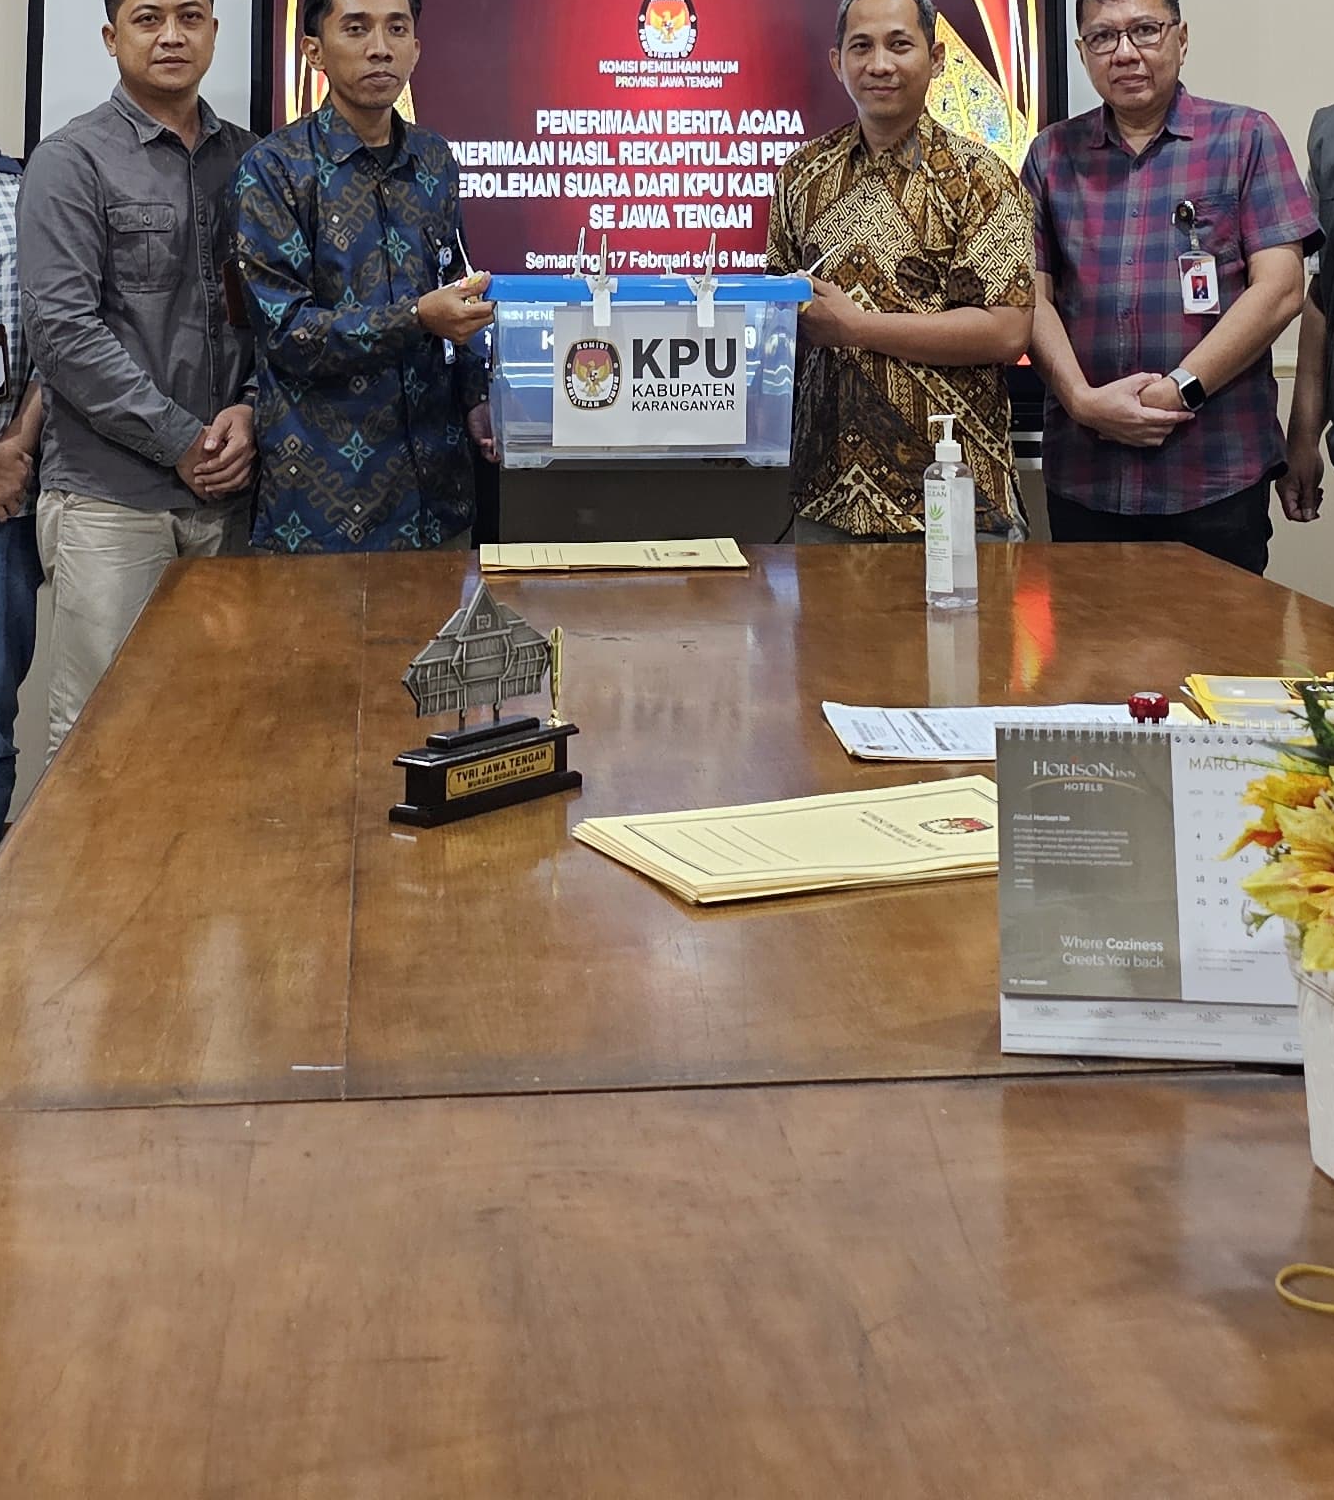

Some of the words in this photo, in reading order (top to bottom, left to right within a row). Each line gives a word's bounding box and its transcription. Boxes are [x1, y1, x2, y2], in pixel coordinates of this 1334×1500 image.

[599, 61, 638, 73] KOMISI
[640, 61, 701, 73] PEMILIHAN
[703, 61, 738, 73] UMUM
[616, 76, 658, 88] PROVINSI
[660, 76, 685, 88] JAWA
[686, 76, 722, 88] TENGAH
[536, 110, 662, 134] PENERIMAAN
[667, 110, 733, 134] BERITA
[737, 110, 804, 134] ACARA
[558, 141, 615, 166] HASIL
[619, 141, 757, 166] REKAPITULASI
[564, 172, 634, 198] SUARA
[636, 172, 679, 198] DARI
[684, 172, 724, 198] KPU
[589, 204, 616, 229] SE
[618, 204, 669, 229] JAWA
[673, 204, 752, 229] TENGAH
[607, 251, 627, 269] 17
[629, 250, 691, 269] Februari
[719, 251, 729, 269] 6
[632, 338, 737, 379] KPU
[632, 383, 735, 398] KABUPATEN
[631, 400, 735, 412] KARANGANYAR
[456, 770, 479, 783] TVRI
[481, 761, 507, 776] JAWA
[508, 749, 547, 768] TENGAH
[1189, 756, 1247, 771] MARCH
[1116, 770, 1136, 778] INN
[1064, 783, 1103, 792] HOTELS
[1060, 935, 1103, 950] Where
[1105, 937, 1164, 951] Coziness
[1062, 952, 1104, 966] Greets
[1105, 954, 1131, 968] You
[1133, 954, 1164, 968] back
